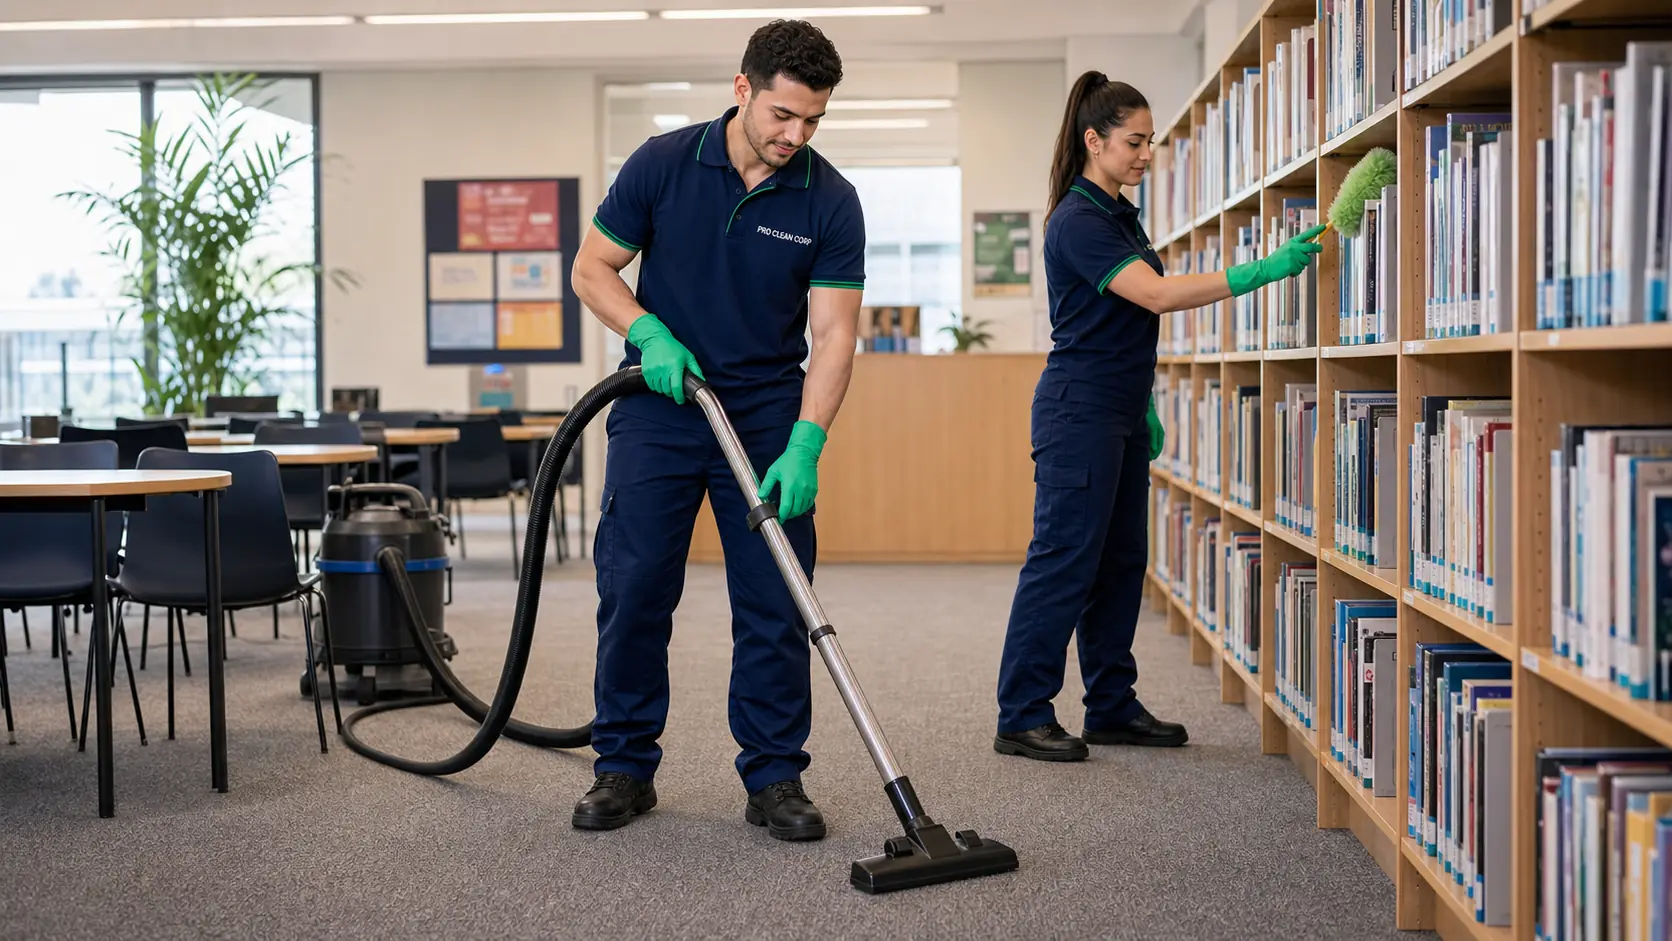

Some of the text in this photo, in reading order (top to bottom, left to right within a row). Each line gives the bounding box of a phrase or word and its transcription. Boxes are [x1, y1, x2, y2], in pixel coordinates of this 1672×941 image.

[757, 225, 812, 246] PRO CLEAN CORP
